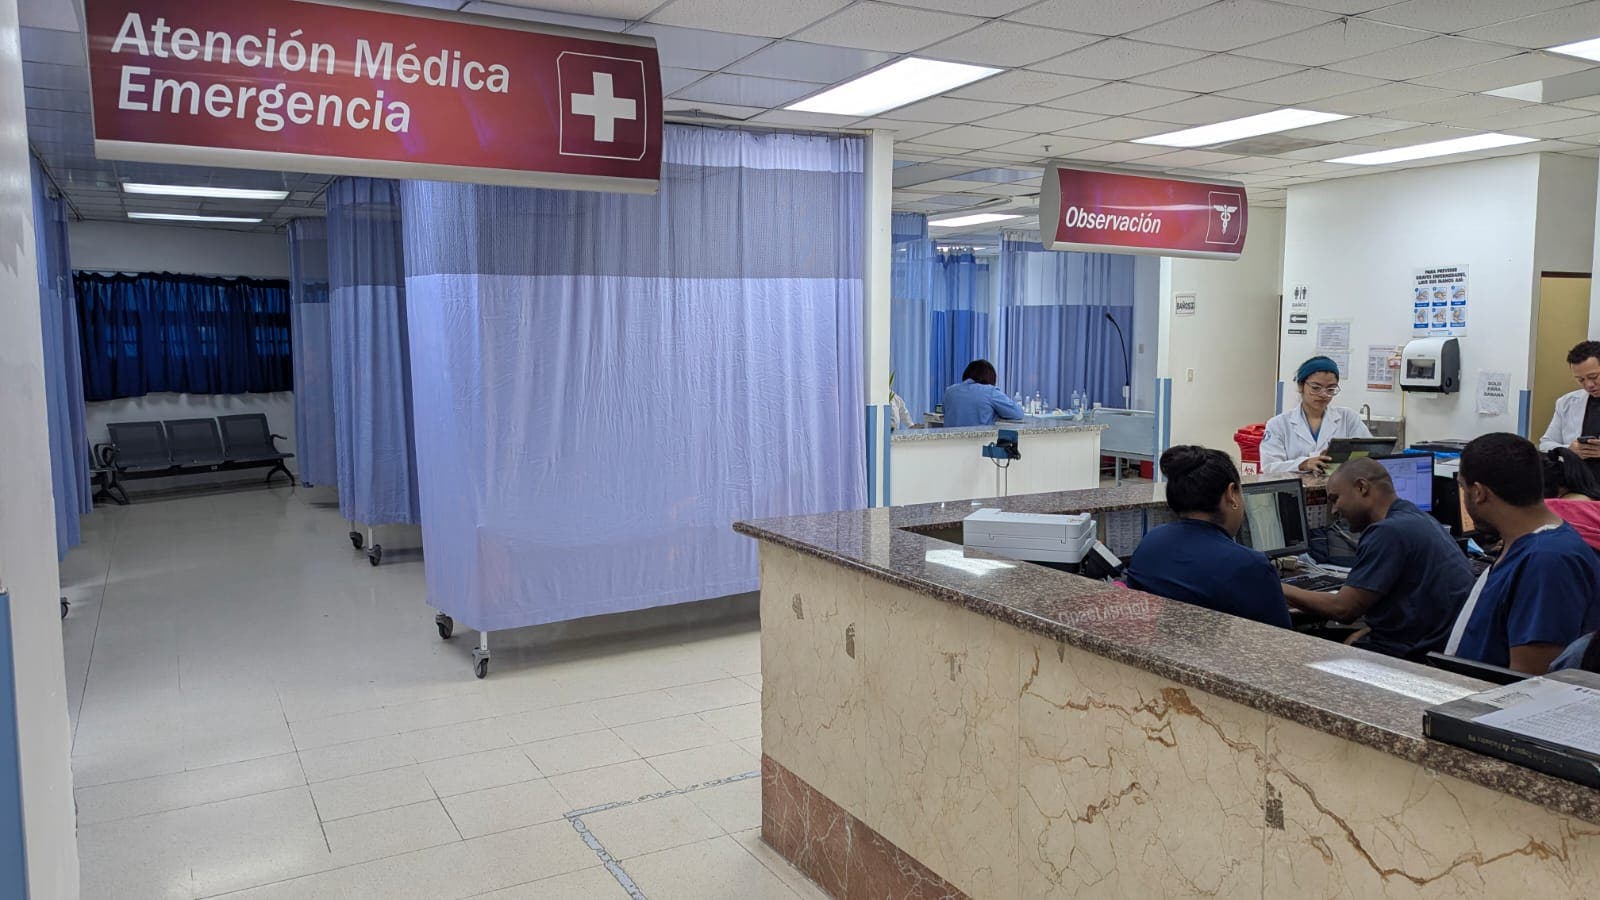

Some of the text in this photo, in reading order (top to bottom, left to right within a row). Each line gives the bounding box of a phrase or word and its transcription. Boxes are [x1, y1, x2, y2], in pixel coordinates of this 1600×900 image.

[110, 13, 510, 94] Atención Médica
[118, 65, 411, 133] Emergencia
[1065, 206, 1162, 234] Observación
